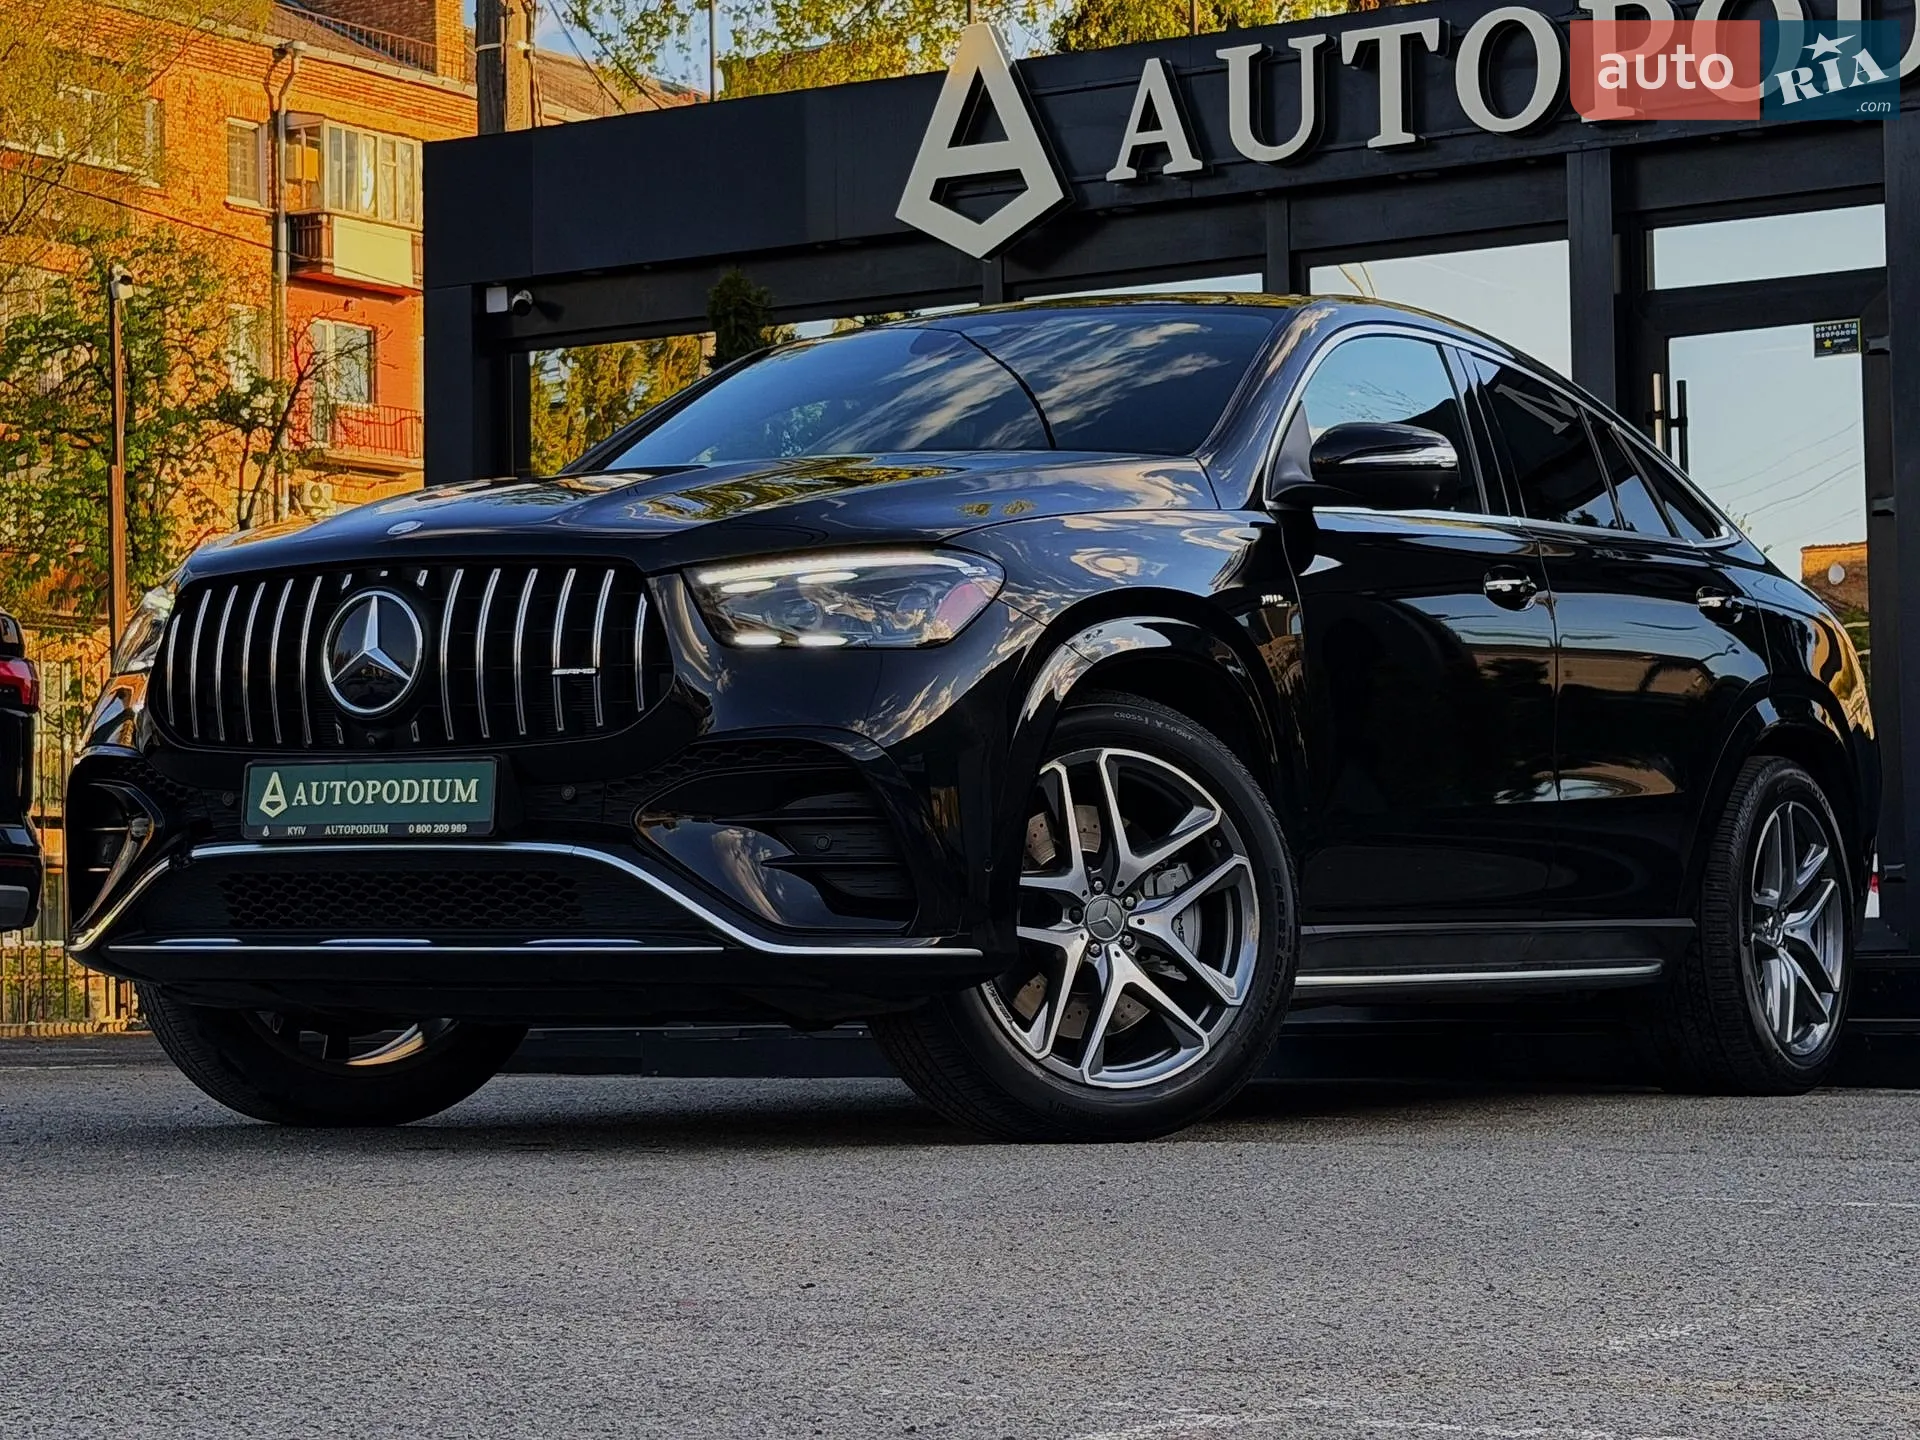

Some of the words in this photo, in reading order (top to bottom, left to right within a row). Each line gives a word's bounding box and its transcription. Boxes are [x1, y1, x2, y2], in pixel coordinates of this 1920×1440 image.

[291, 778, 480, 806] AUTOPODIUM
[287, 825, 307, 836] KYIV
[324, 824, 389, 836] AUTOPODIUM
[408, 825, 415, 834] 0
[415, 824, 432, 834] 800
[432, 824, 450, 834] 209
